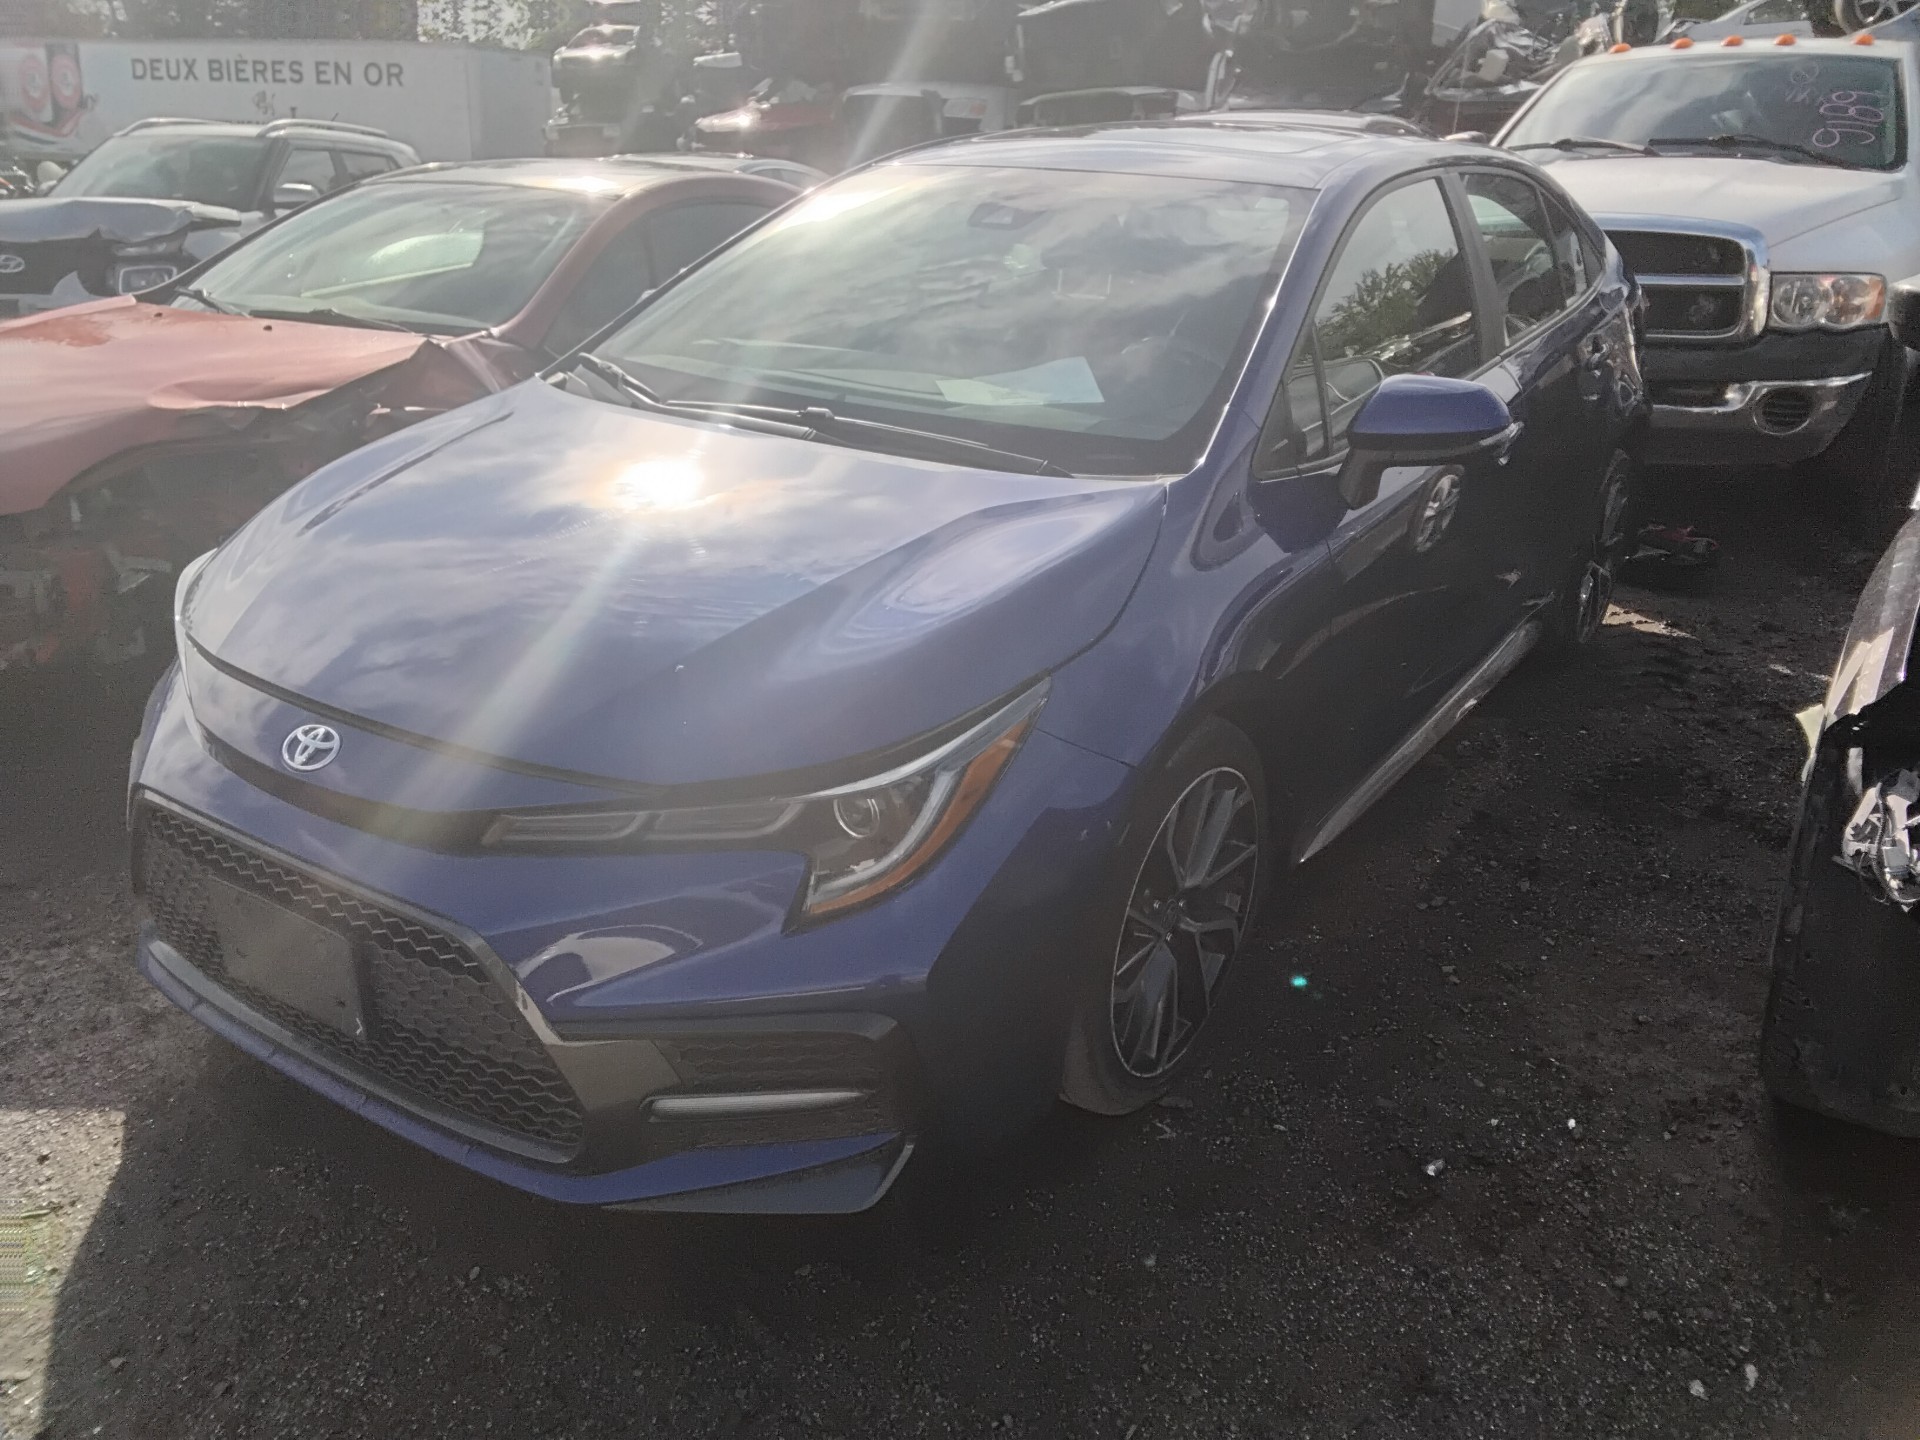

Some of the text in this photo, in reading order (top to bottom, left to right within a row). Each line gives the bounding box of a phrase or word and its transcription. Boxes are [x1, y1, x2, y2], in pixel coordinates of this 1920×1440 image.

[131, 53, 404, 87] DEUX BIÈRES EN OR
